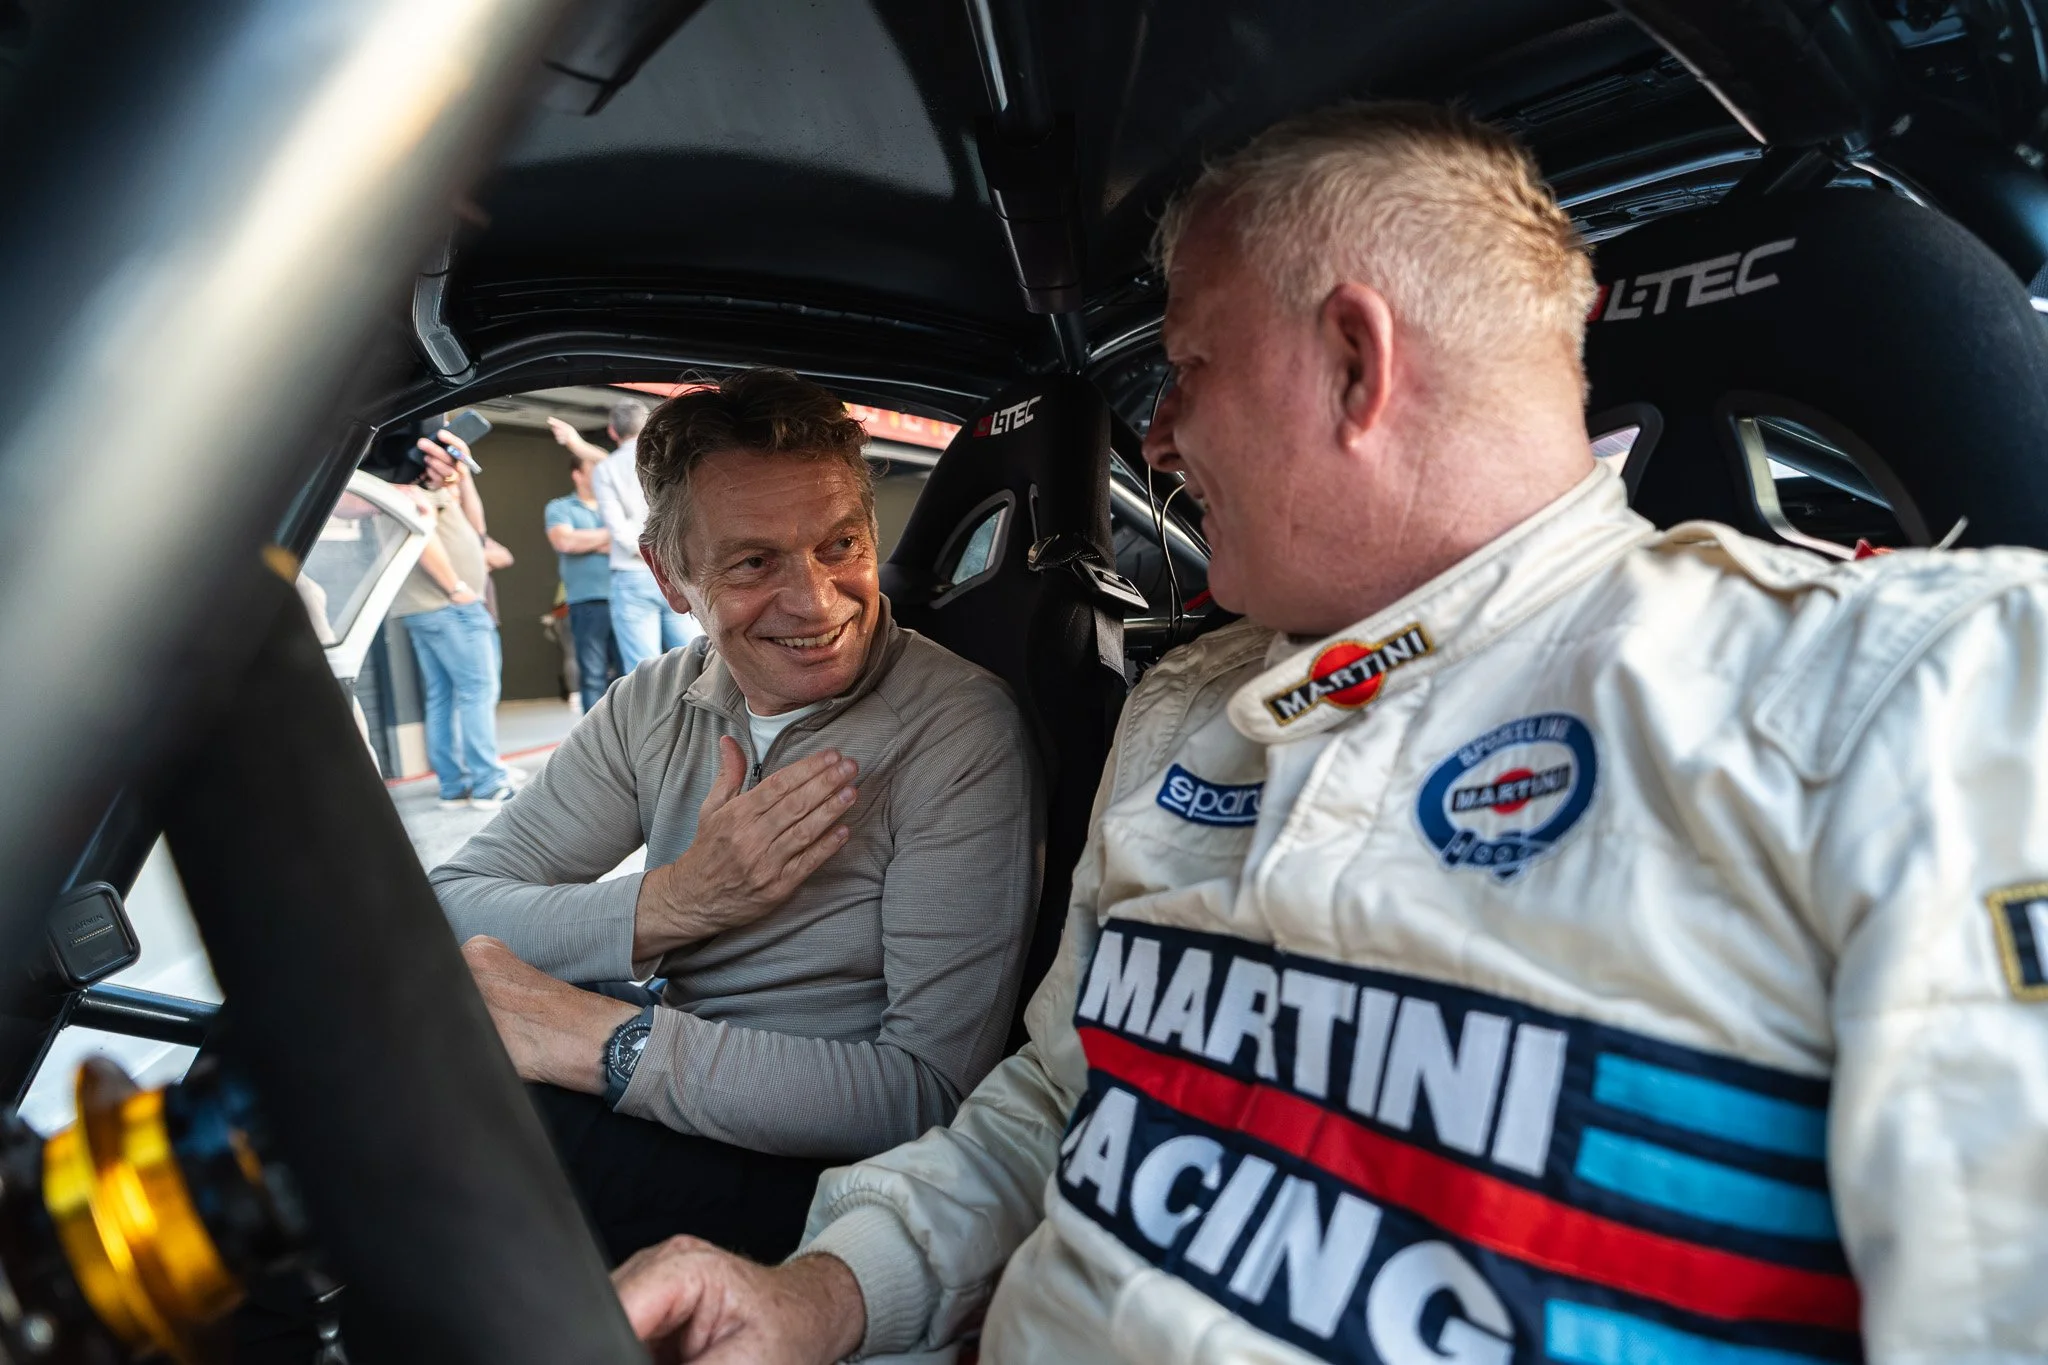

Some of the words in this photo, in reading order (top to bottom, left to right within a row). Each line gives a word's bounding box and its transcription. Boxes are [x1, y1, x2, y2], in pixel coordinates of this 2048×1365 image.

[1274, 630, 1426, 720] MARTINI
[1077, 930, 1569, 1178] MARTINI
[1061, 1086, 1515, 1365] ACING
